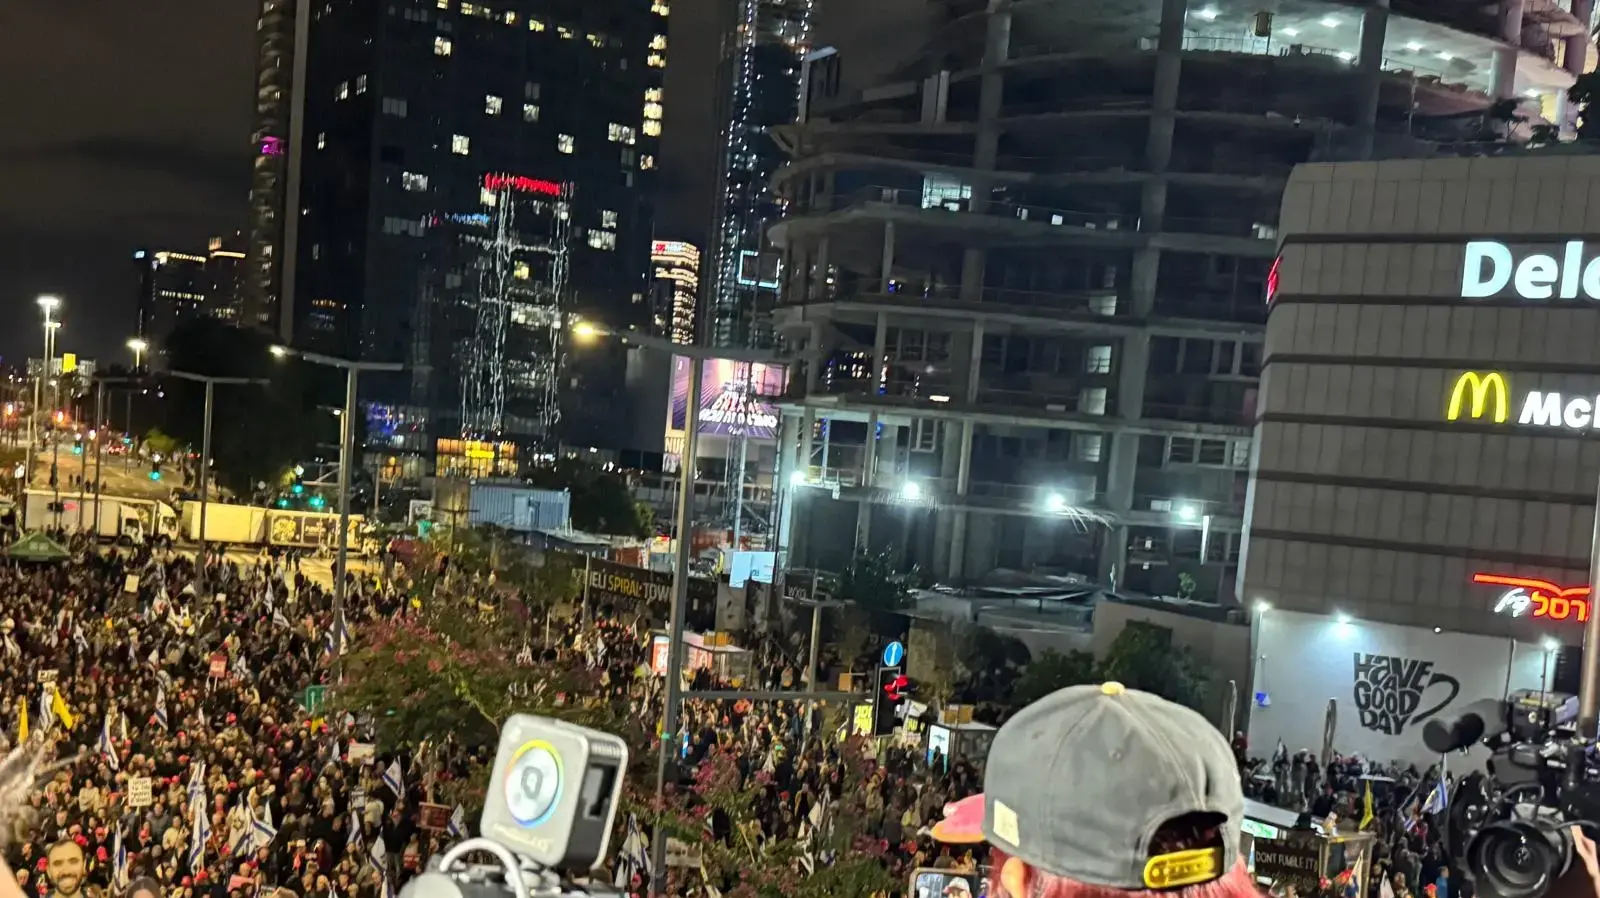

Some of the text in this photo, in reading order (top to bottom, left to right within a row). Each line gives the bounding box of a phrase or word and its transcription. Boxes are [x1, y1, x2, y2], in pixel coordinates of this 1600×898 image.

[1519, 390, 1600, 428] Mc
[608, 575, 641, 597] SPIRAL
[643, 582, 673, 602] TOW
[1531, 590, 1591, 622] רסל
[1381, 674, 1398, 691] A
[1354, 679, 1422, 716] GOOD
[1359, 709, 1412, 736] DAY
